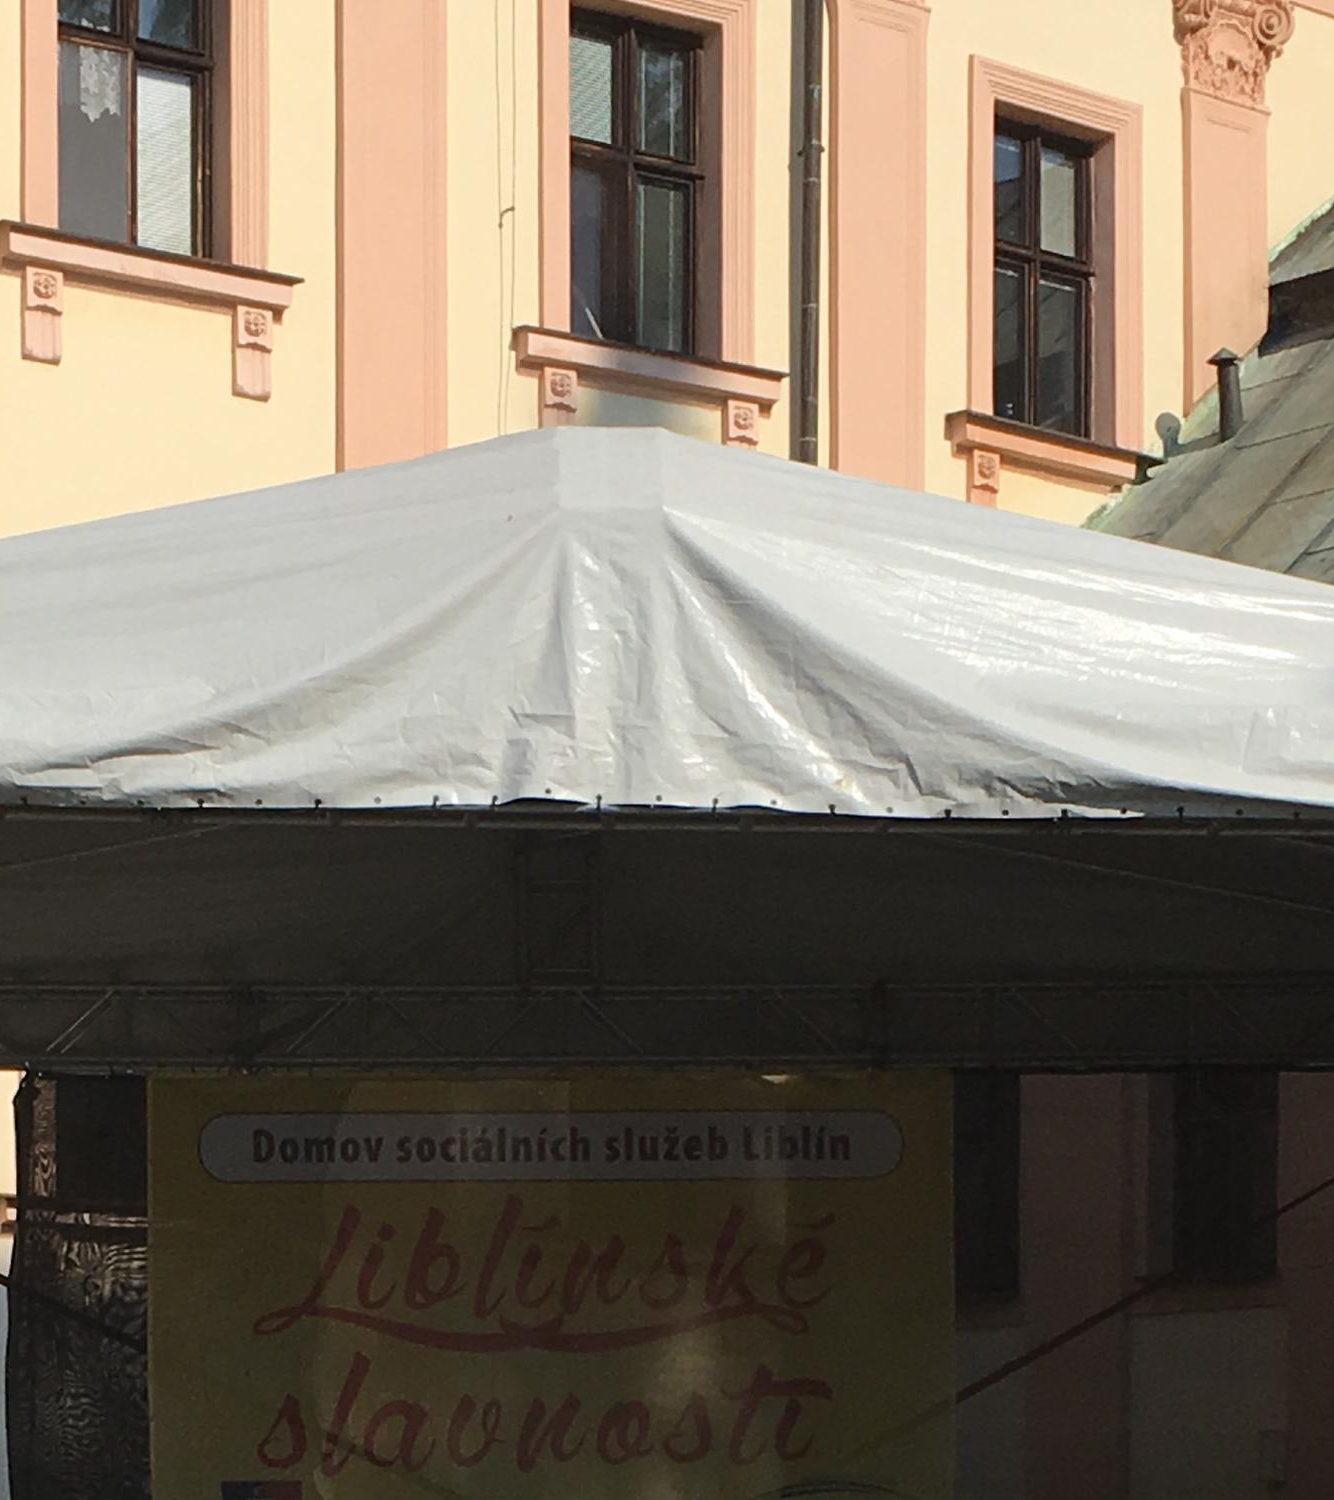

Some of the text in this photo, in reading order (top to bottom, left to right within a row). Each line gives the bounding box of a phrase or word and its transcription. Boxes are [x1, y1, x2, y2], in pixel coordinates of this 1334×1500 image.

[252, 1117, 853, 1165] Domov sociálních služeb Liblín
[253, 1194, 837, 1354] Liblínské
[258, 1352, 834, 1477] slavnosti
